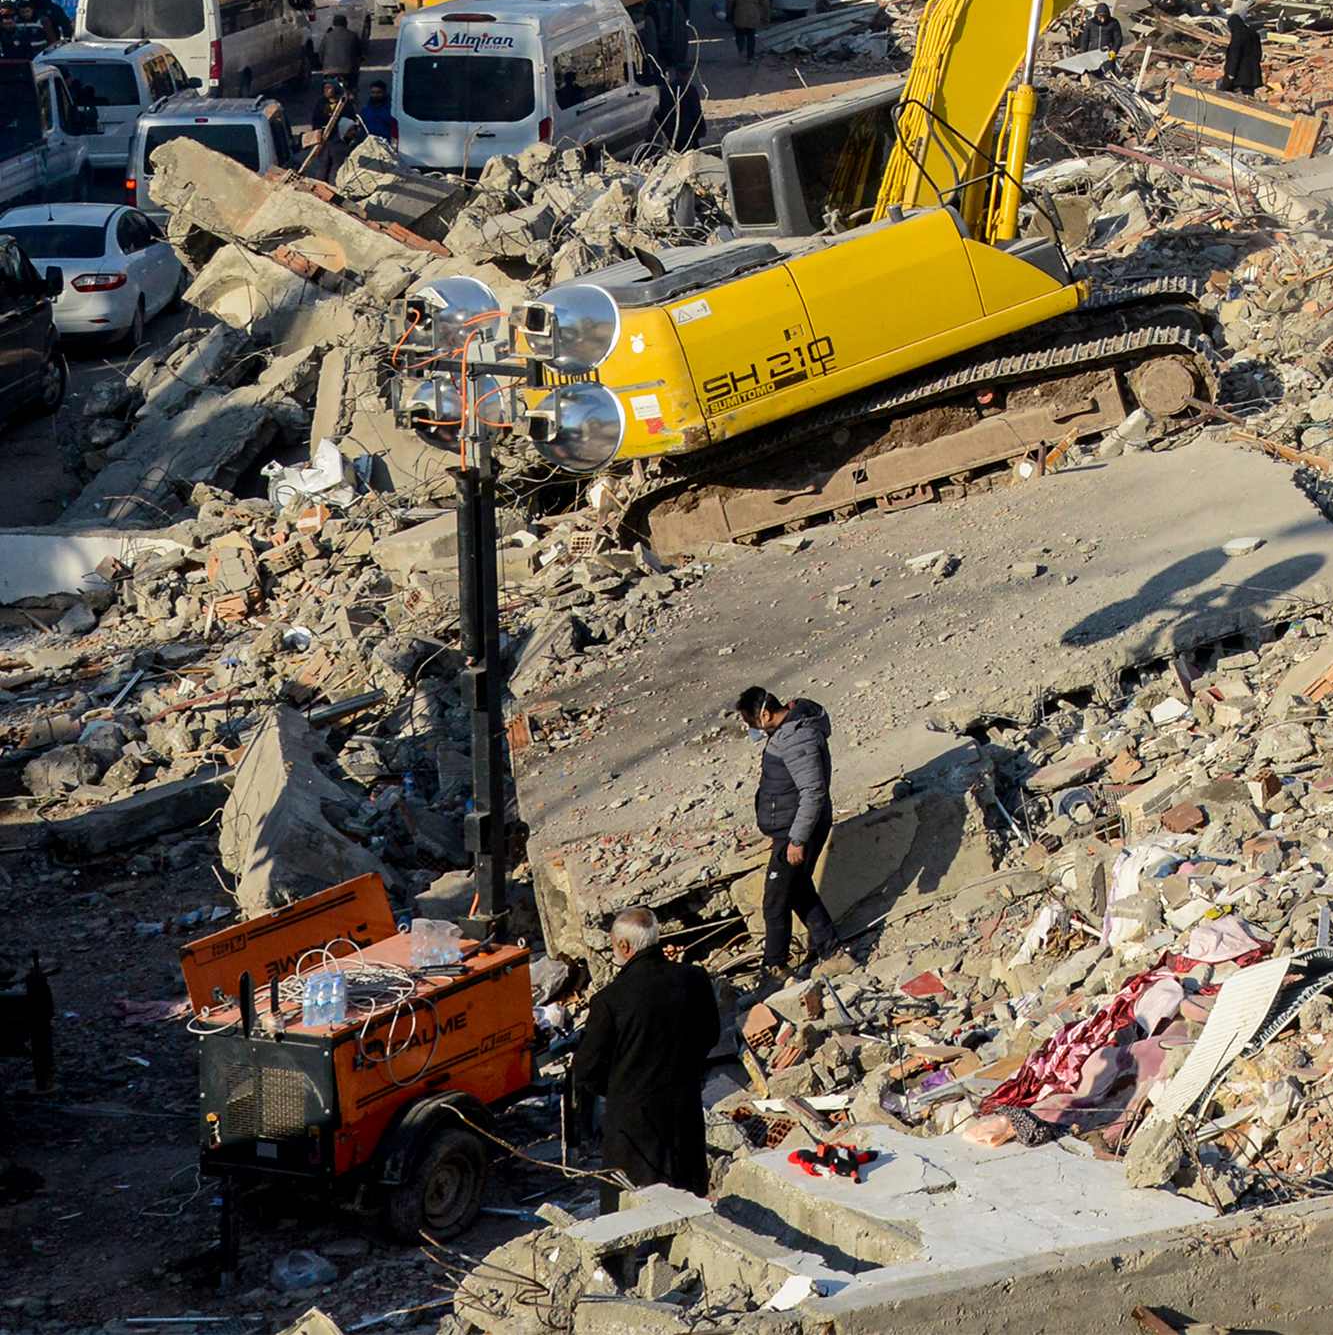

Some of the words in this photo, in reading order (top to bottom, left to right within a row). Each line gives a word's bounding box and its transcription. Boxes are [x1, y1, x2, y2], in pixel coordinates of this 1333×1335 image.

[703, 364, 760, 403] SH
[766, 336, 835, 379] 210
[711, 382, 776, 414] SUMITOMO
